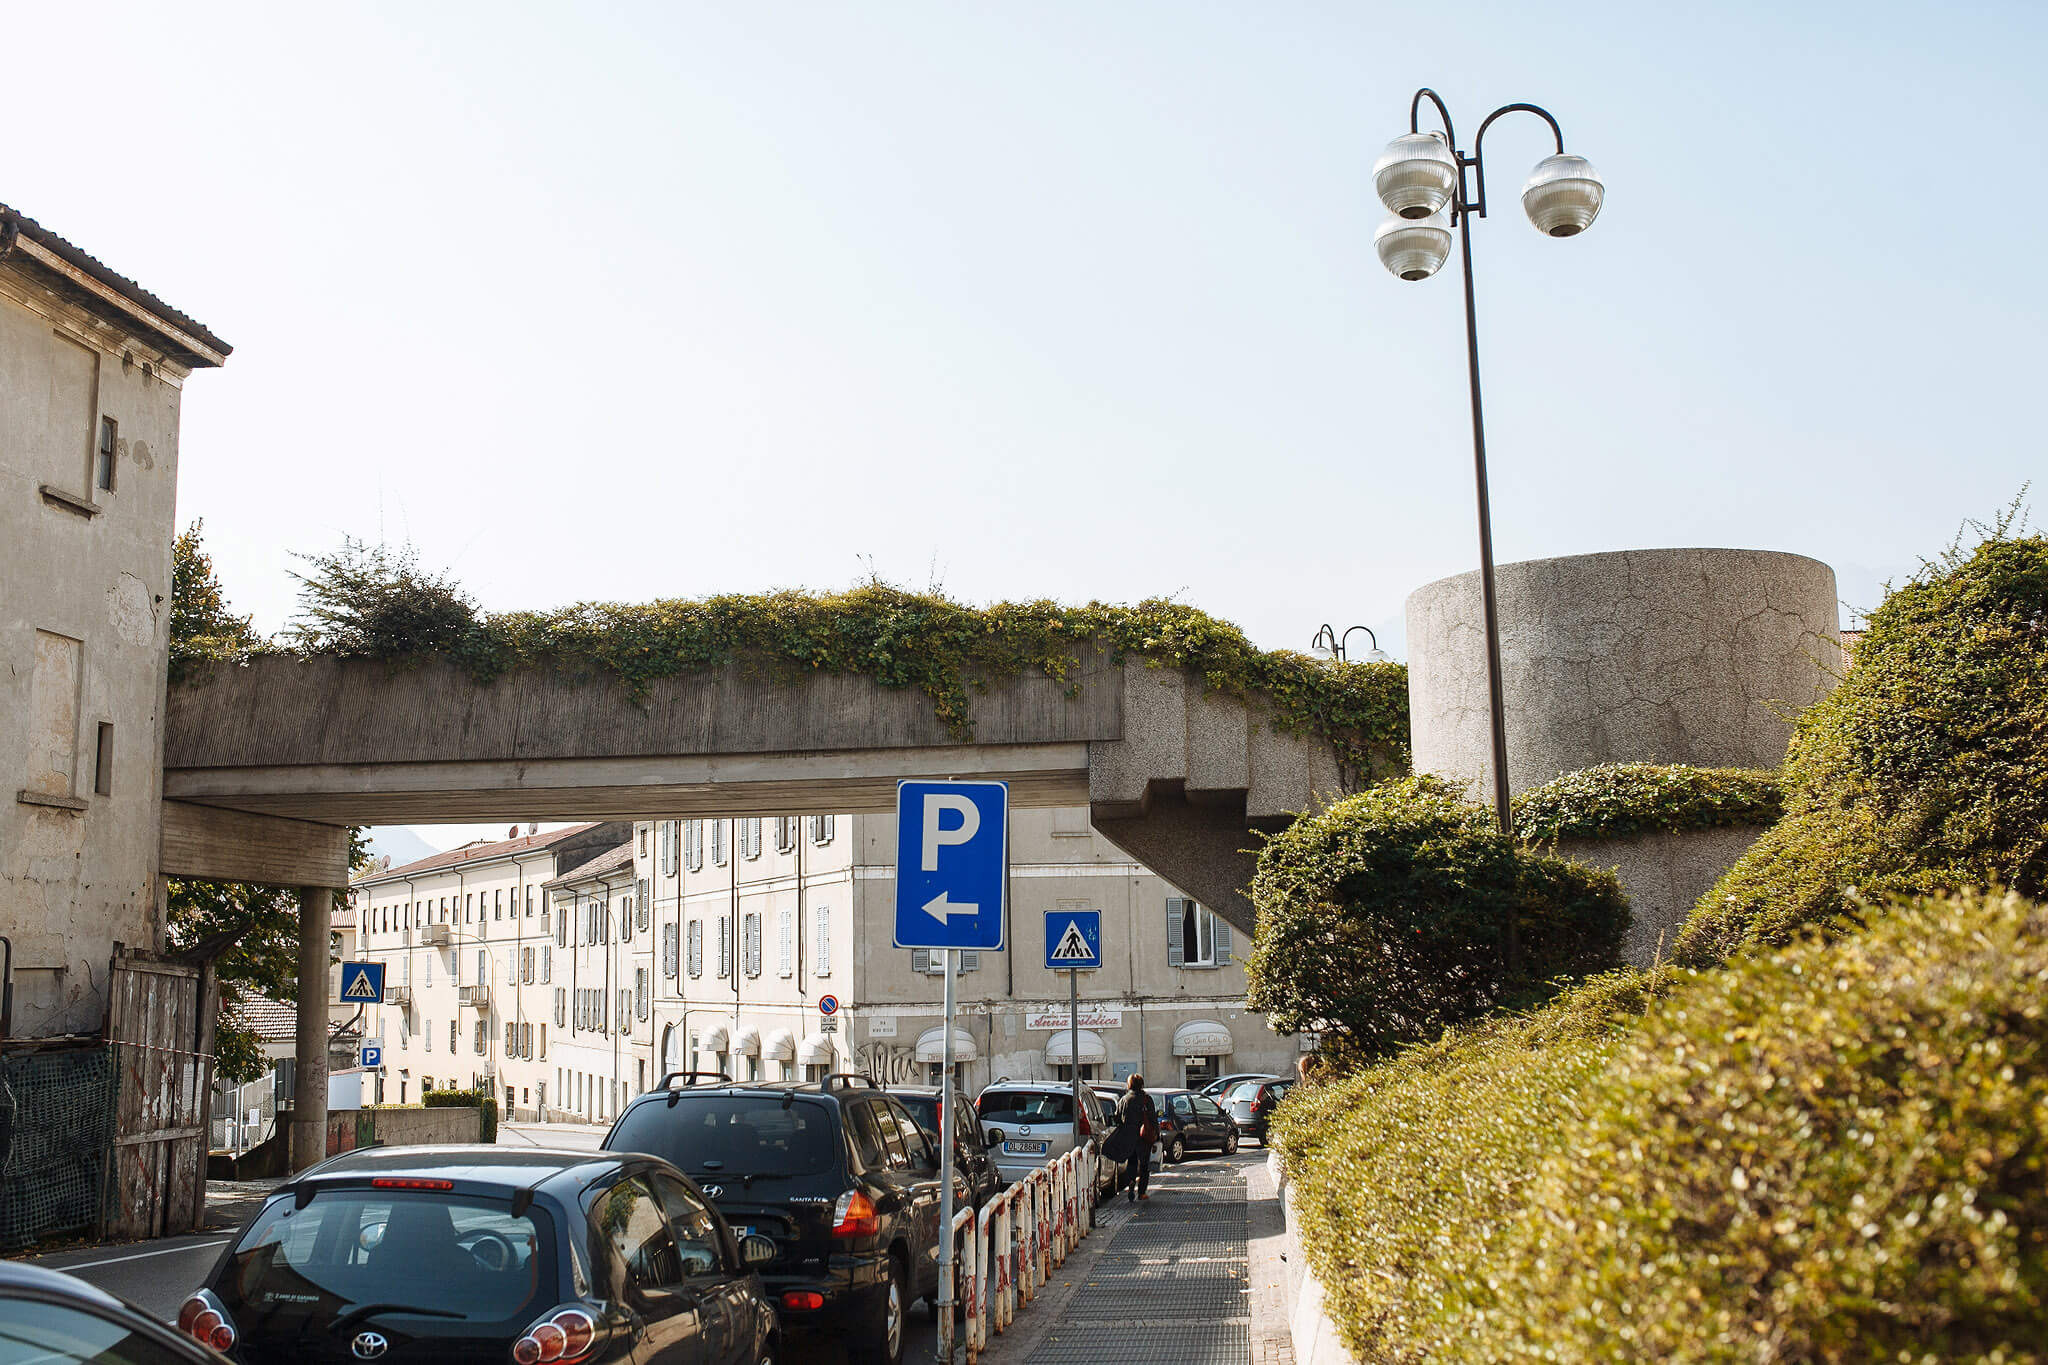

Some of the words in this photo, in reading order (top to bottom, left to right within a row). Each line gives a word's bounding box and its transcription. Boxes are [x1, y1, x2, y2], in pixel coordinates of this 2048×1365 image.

[921, 794, 980, 871] P
[1029, 1014, 1068, 1028] Anna
[366, 1050, 377, 1064] P
